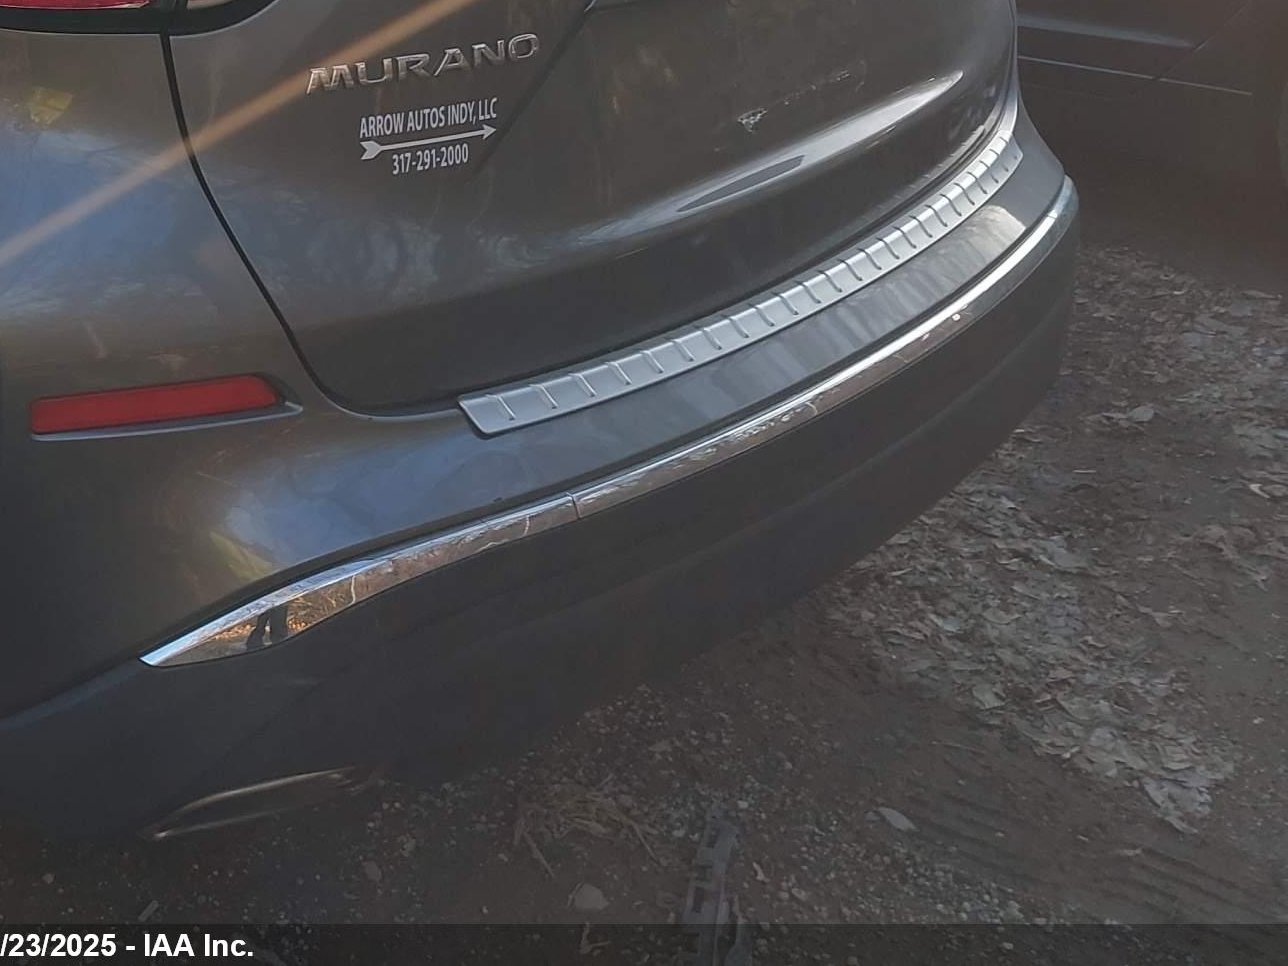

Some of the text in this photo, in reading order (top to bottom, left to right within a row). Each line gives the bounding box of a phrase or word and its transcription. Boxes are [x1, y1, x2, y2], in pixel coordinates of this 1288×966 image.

[306, 33, 541, 95] MURANO
[359, 97, 498, 139] ARROW AUTOS INDY, LLC
[392, 143, 469, 175] 317-291-2000
